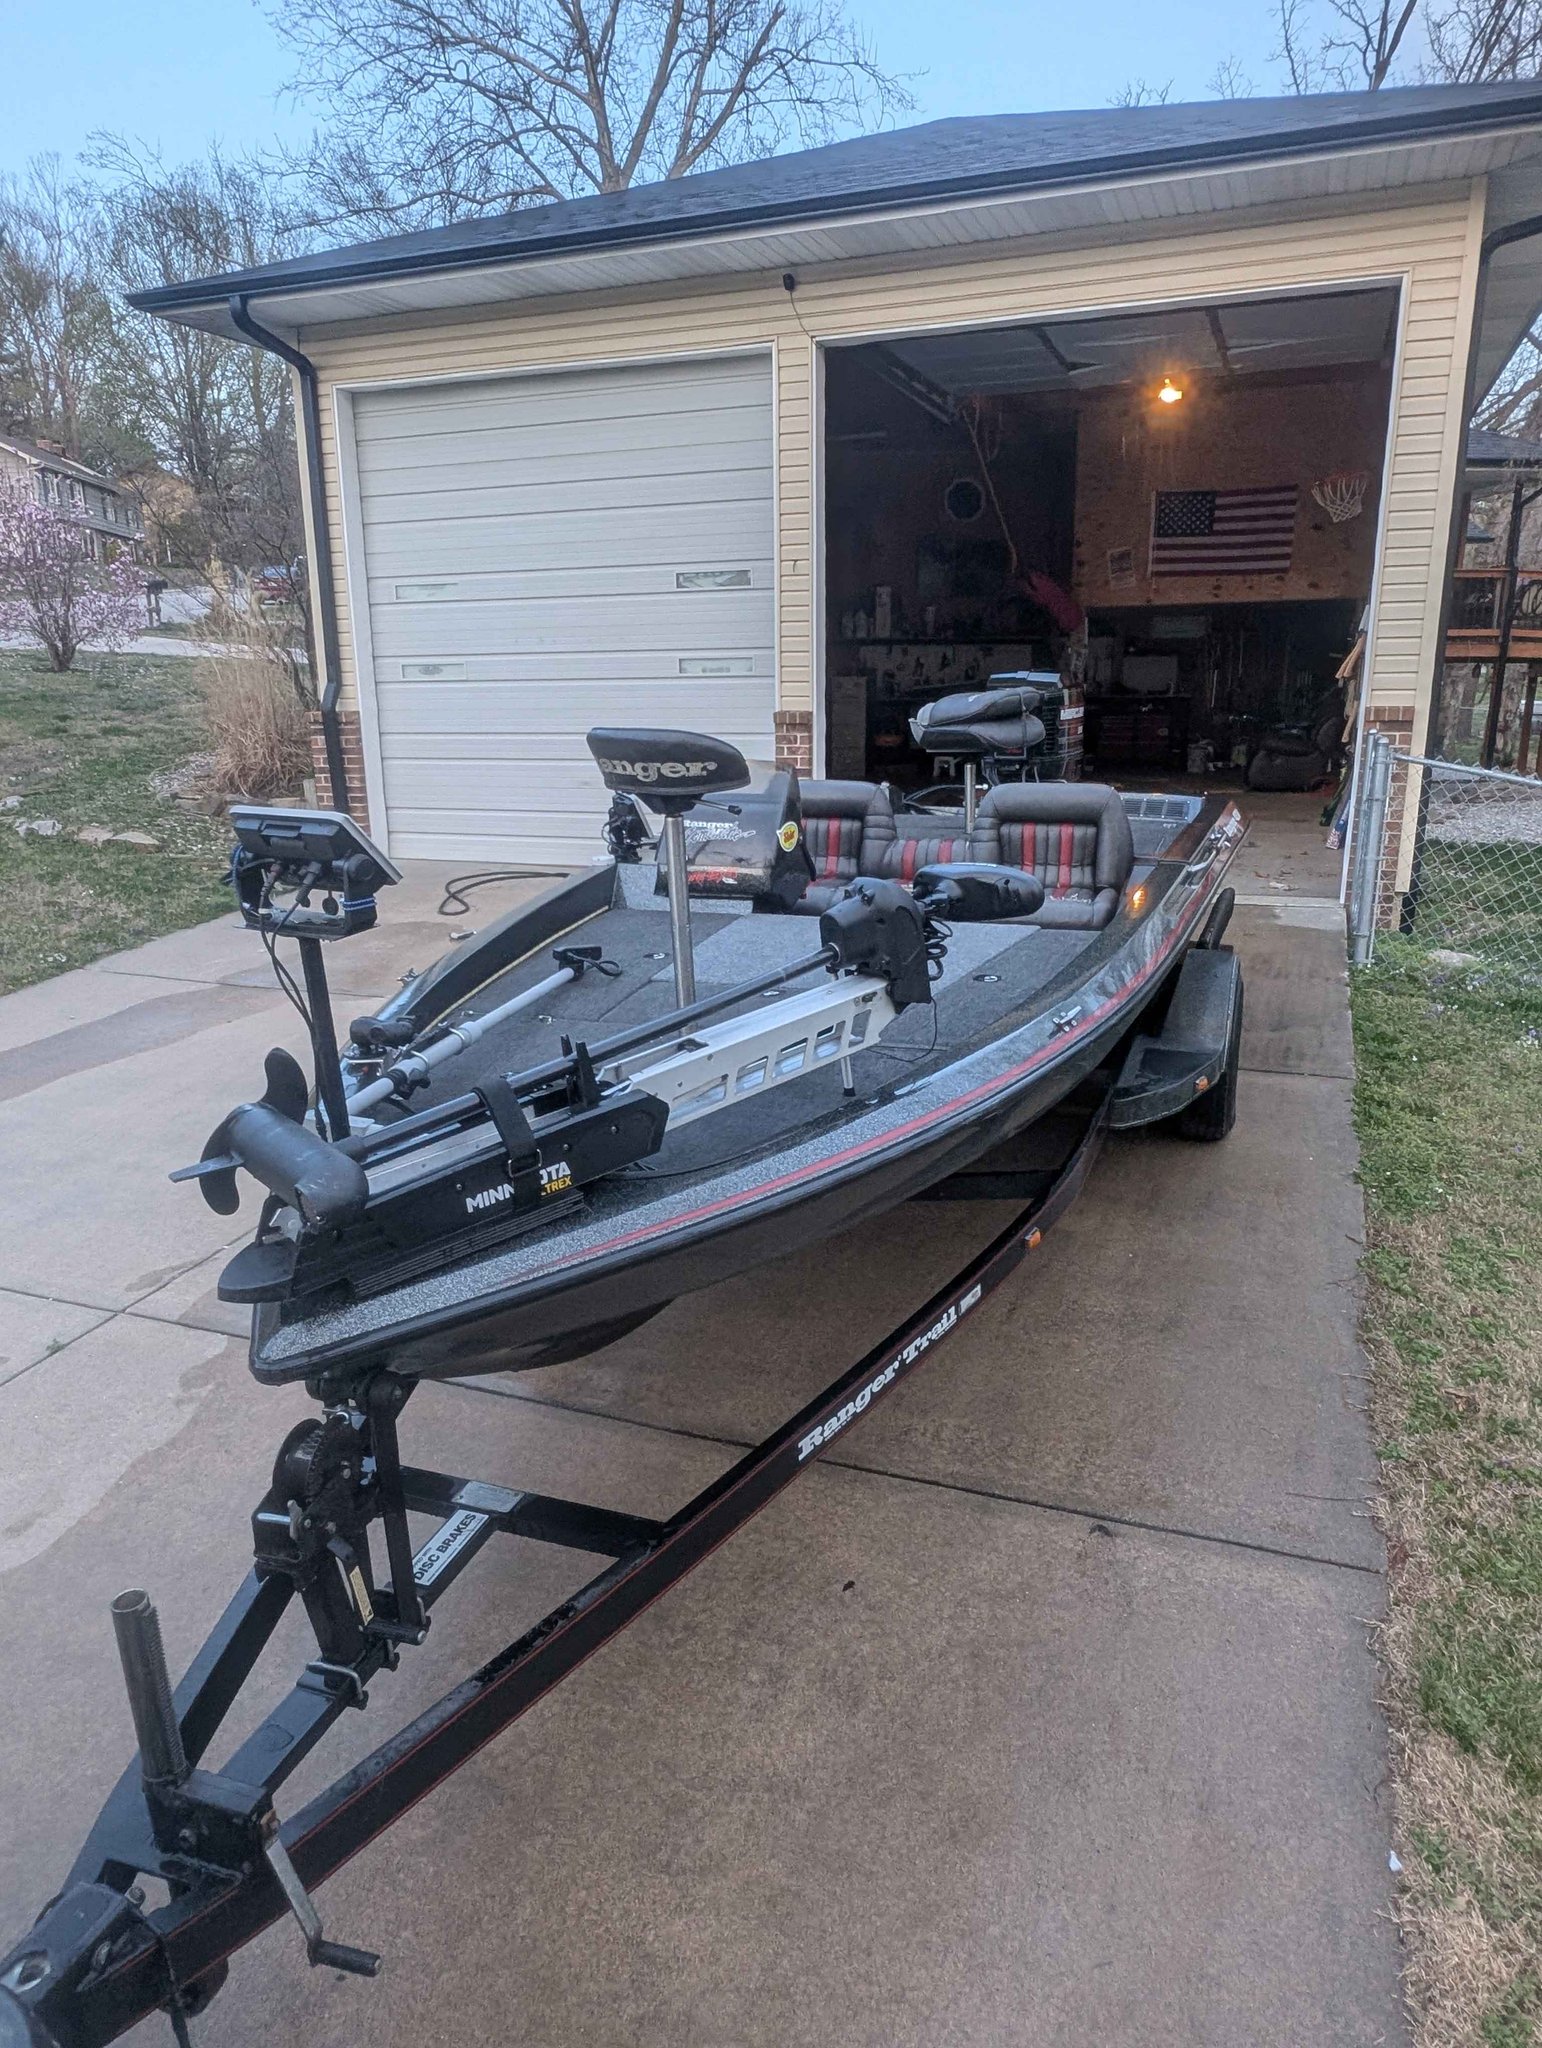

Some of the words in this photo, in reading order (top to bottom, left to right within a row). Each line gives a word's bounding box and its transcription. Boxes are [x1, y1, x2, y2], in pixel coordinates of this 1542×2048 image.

[599, 759, 718, 782] anger
[539, 1161, 571, 1185] OTA
[541, 1176, 572, 1196] TREX
[799, 1360, 899, 1461] Ranger
[903, 1305, 957, 1364] Trail
[414, 1554, 440, 1580] DISC
[436, 1513, 477, 1553] BRAKES
